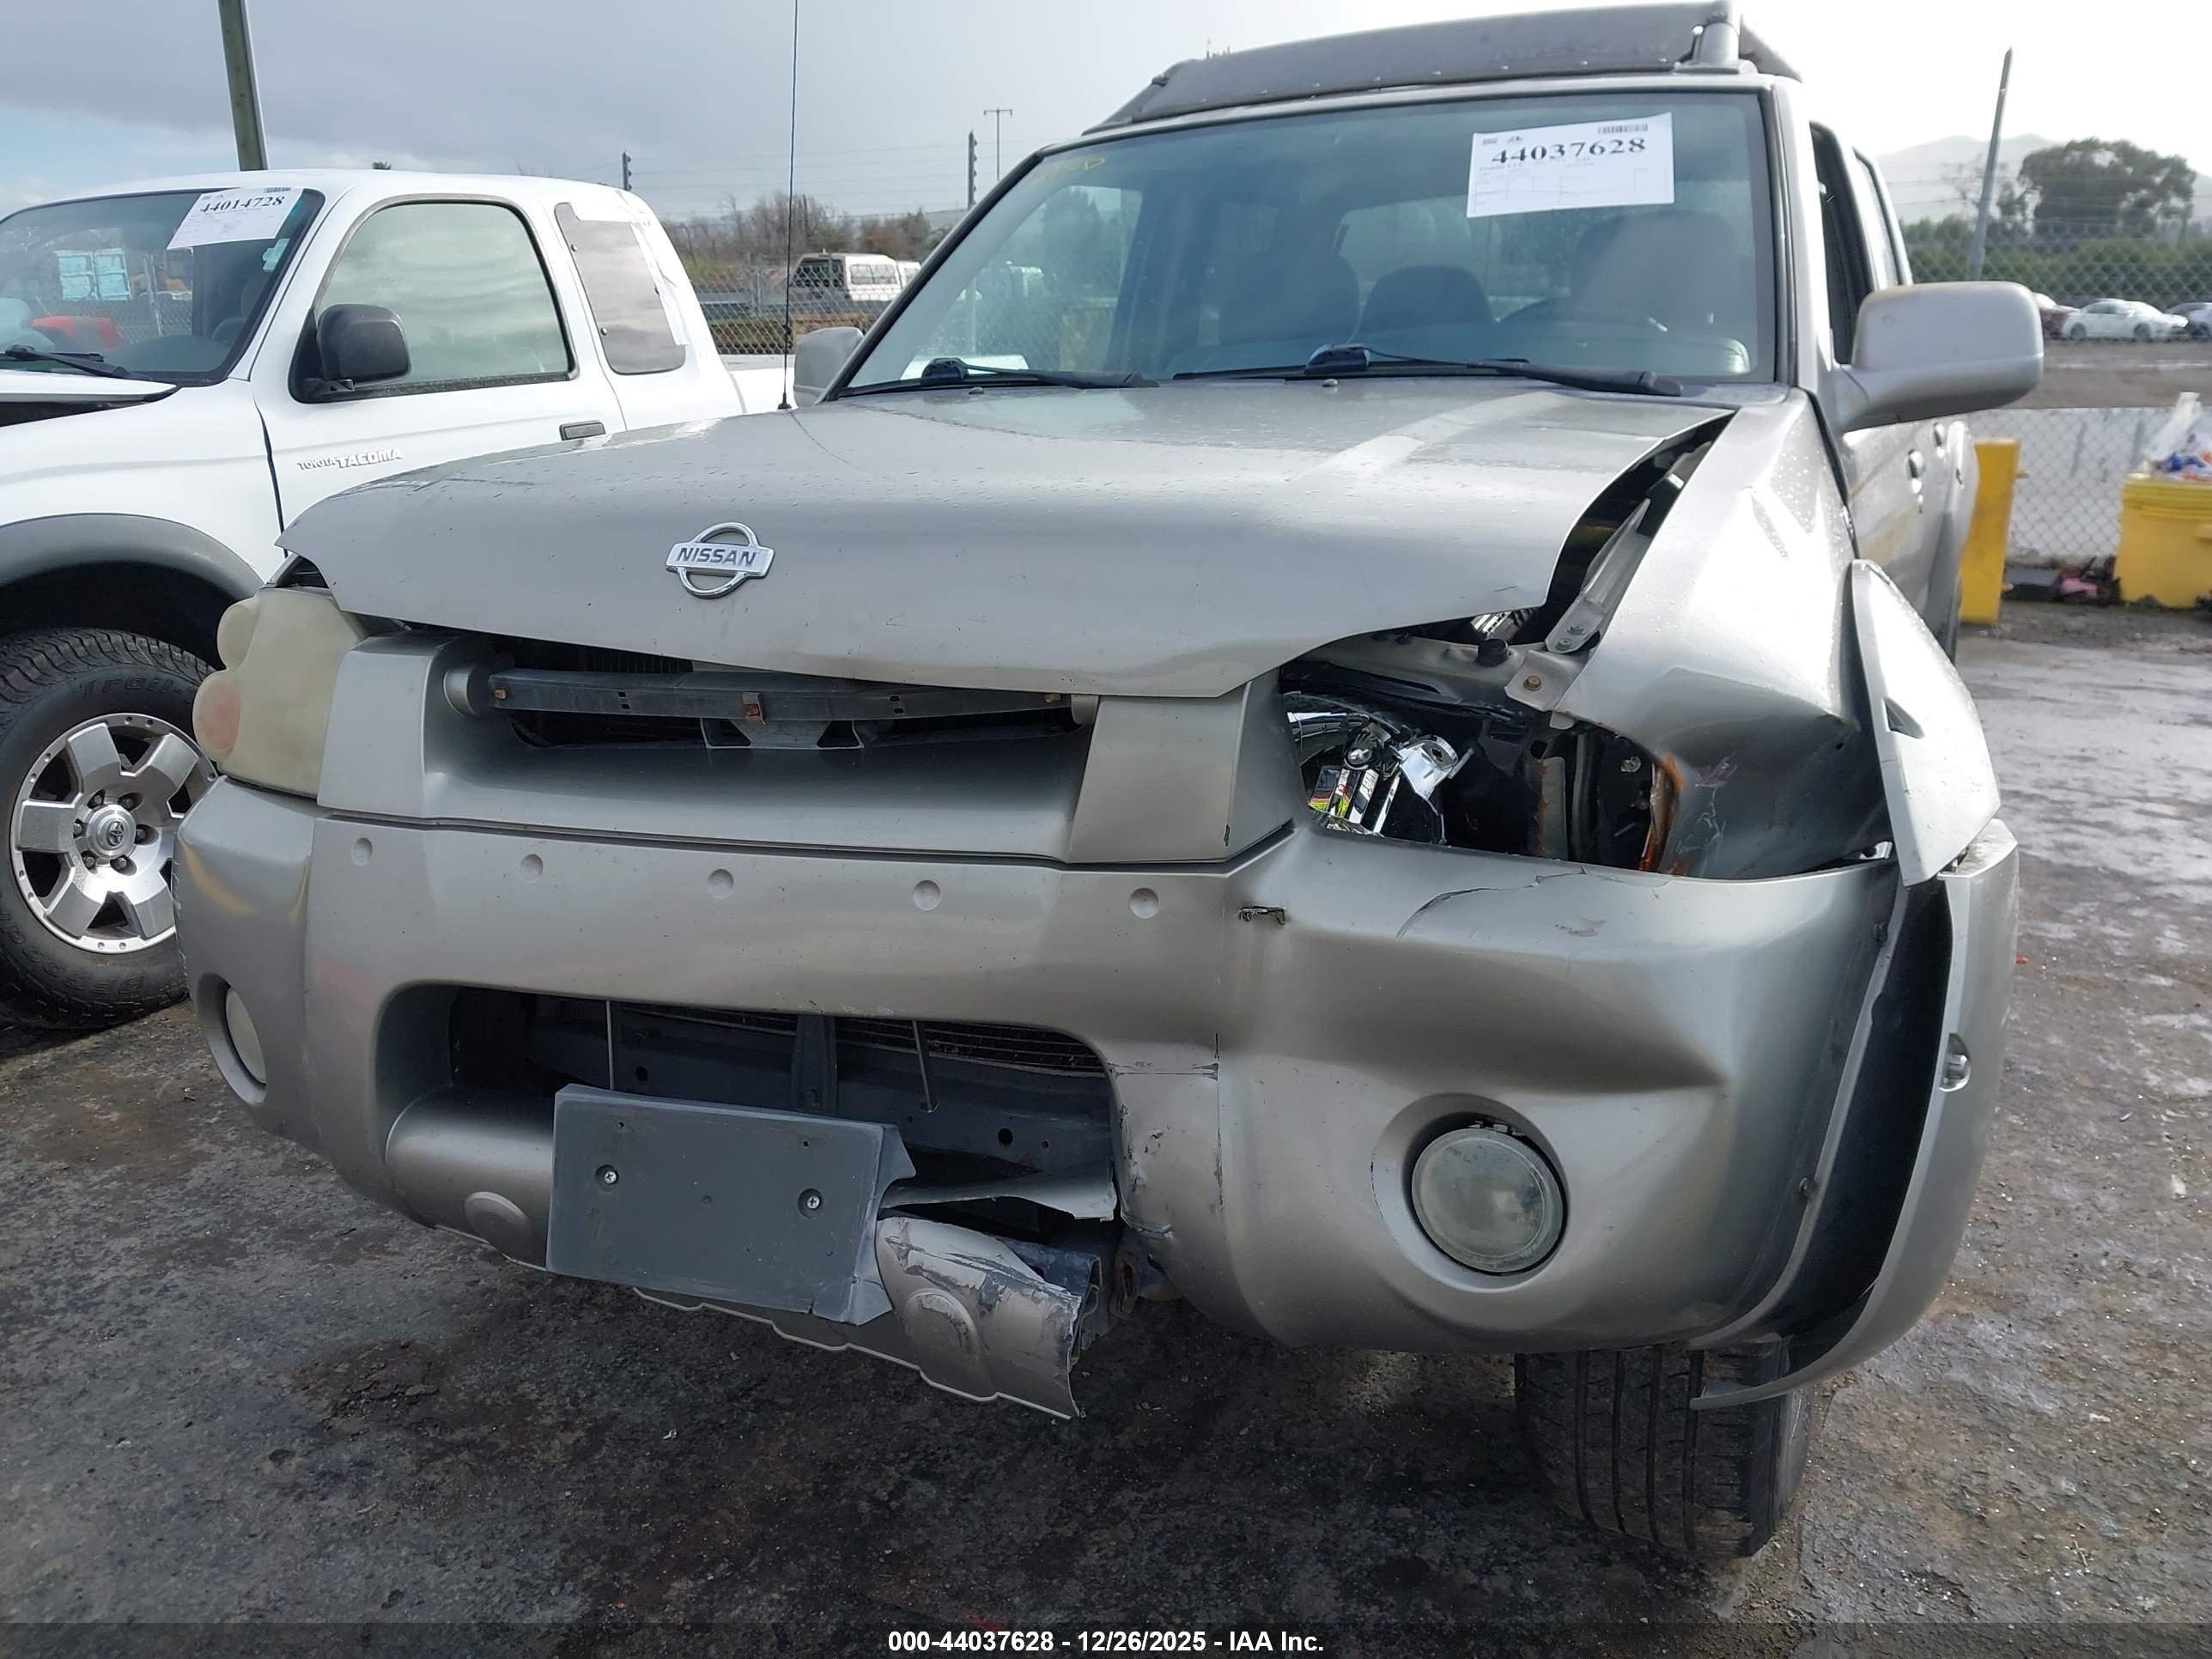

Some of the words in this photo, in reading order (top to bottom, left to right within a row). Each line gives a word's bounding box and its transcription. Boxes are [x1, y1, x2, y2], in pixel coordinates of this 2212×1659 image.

[1492, 137, 1646, 164] 44037628
[200, 195, 285, 213] 44014728
[296, 457, 336, 471] TOYOTA
[336, 447, 403, 469] TACOMA
[676, 547, 757, 567] NISSAN
